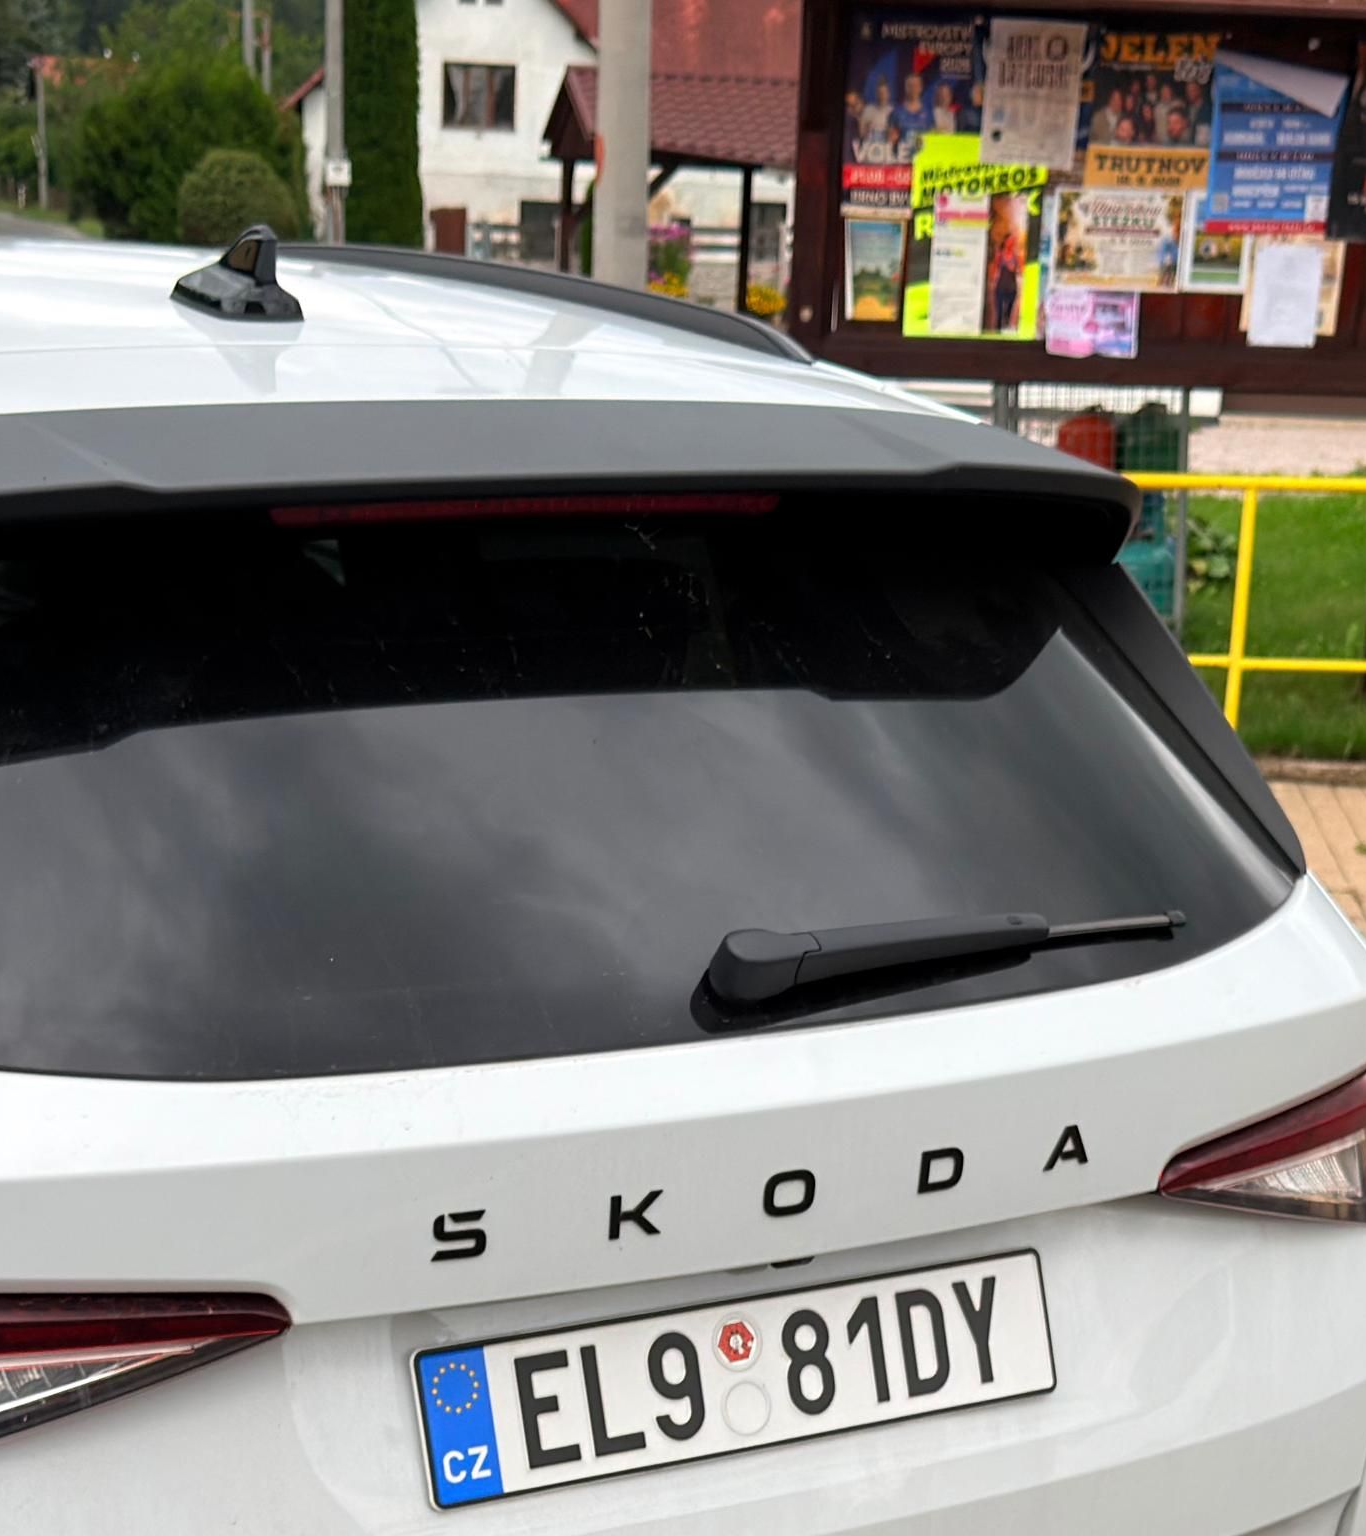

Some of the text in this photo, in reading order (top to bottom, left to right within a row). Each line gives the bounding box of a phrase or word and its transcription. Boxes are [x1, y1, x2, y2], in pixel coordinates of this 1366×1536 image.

[1100, 33, 1221, 63] JELEN
[1096, 154, 1207, 175] TRUTNOV
[514, 1277, 996, 1469] EL9 81DY
[442, 1446, 492, 1484] CZ
